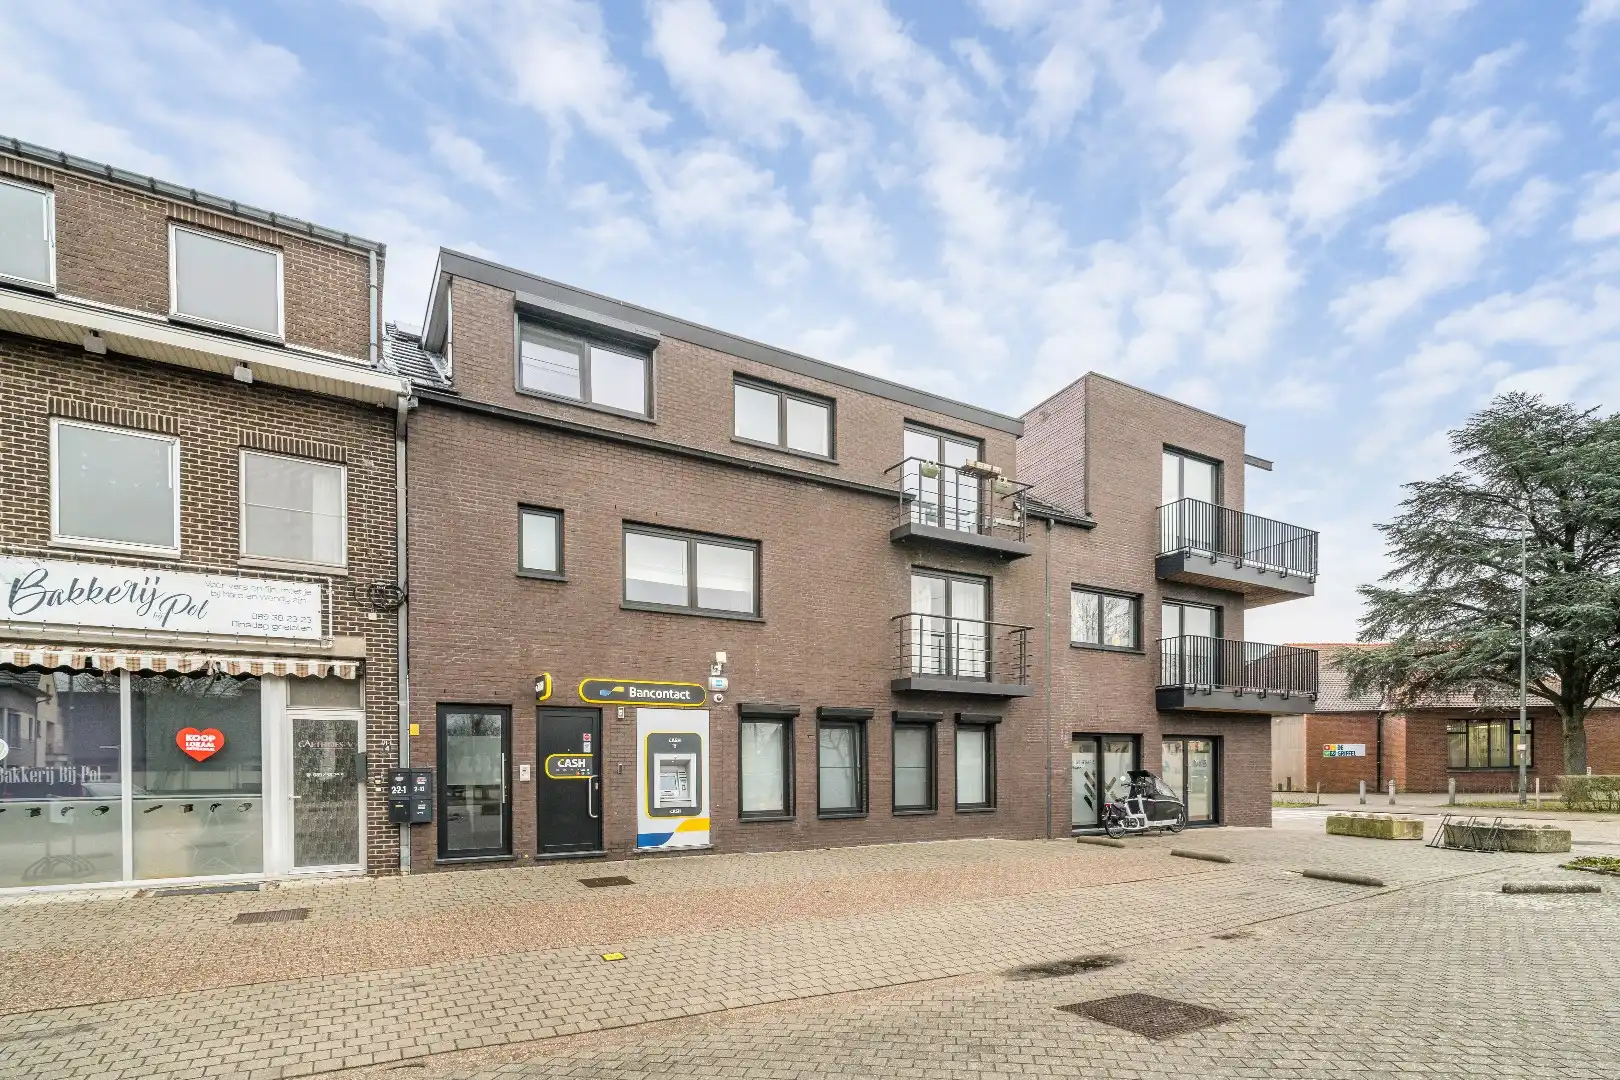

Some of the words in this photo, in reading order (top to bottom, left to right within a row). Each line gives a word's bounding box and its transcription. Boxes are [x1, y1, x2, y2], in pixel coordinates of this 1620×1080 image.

[206, 581, 224, 589] Voor
[8, 568, 165, 617] Bakkerij
[157, 593, 209, 627] Pol
[629, 687, 691, 700] Bancontact
[185, 733, 216, 742] KOOP
[557, 758, 586, 768] CASH
[0, 766, 54, 786] Bakkerij
[59, 766, 77, 785] Bij
[81, 765, 101, 783] Pol
